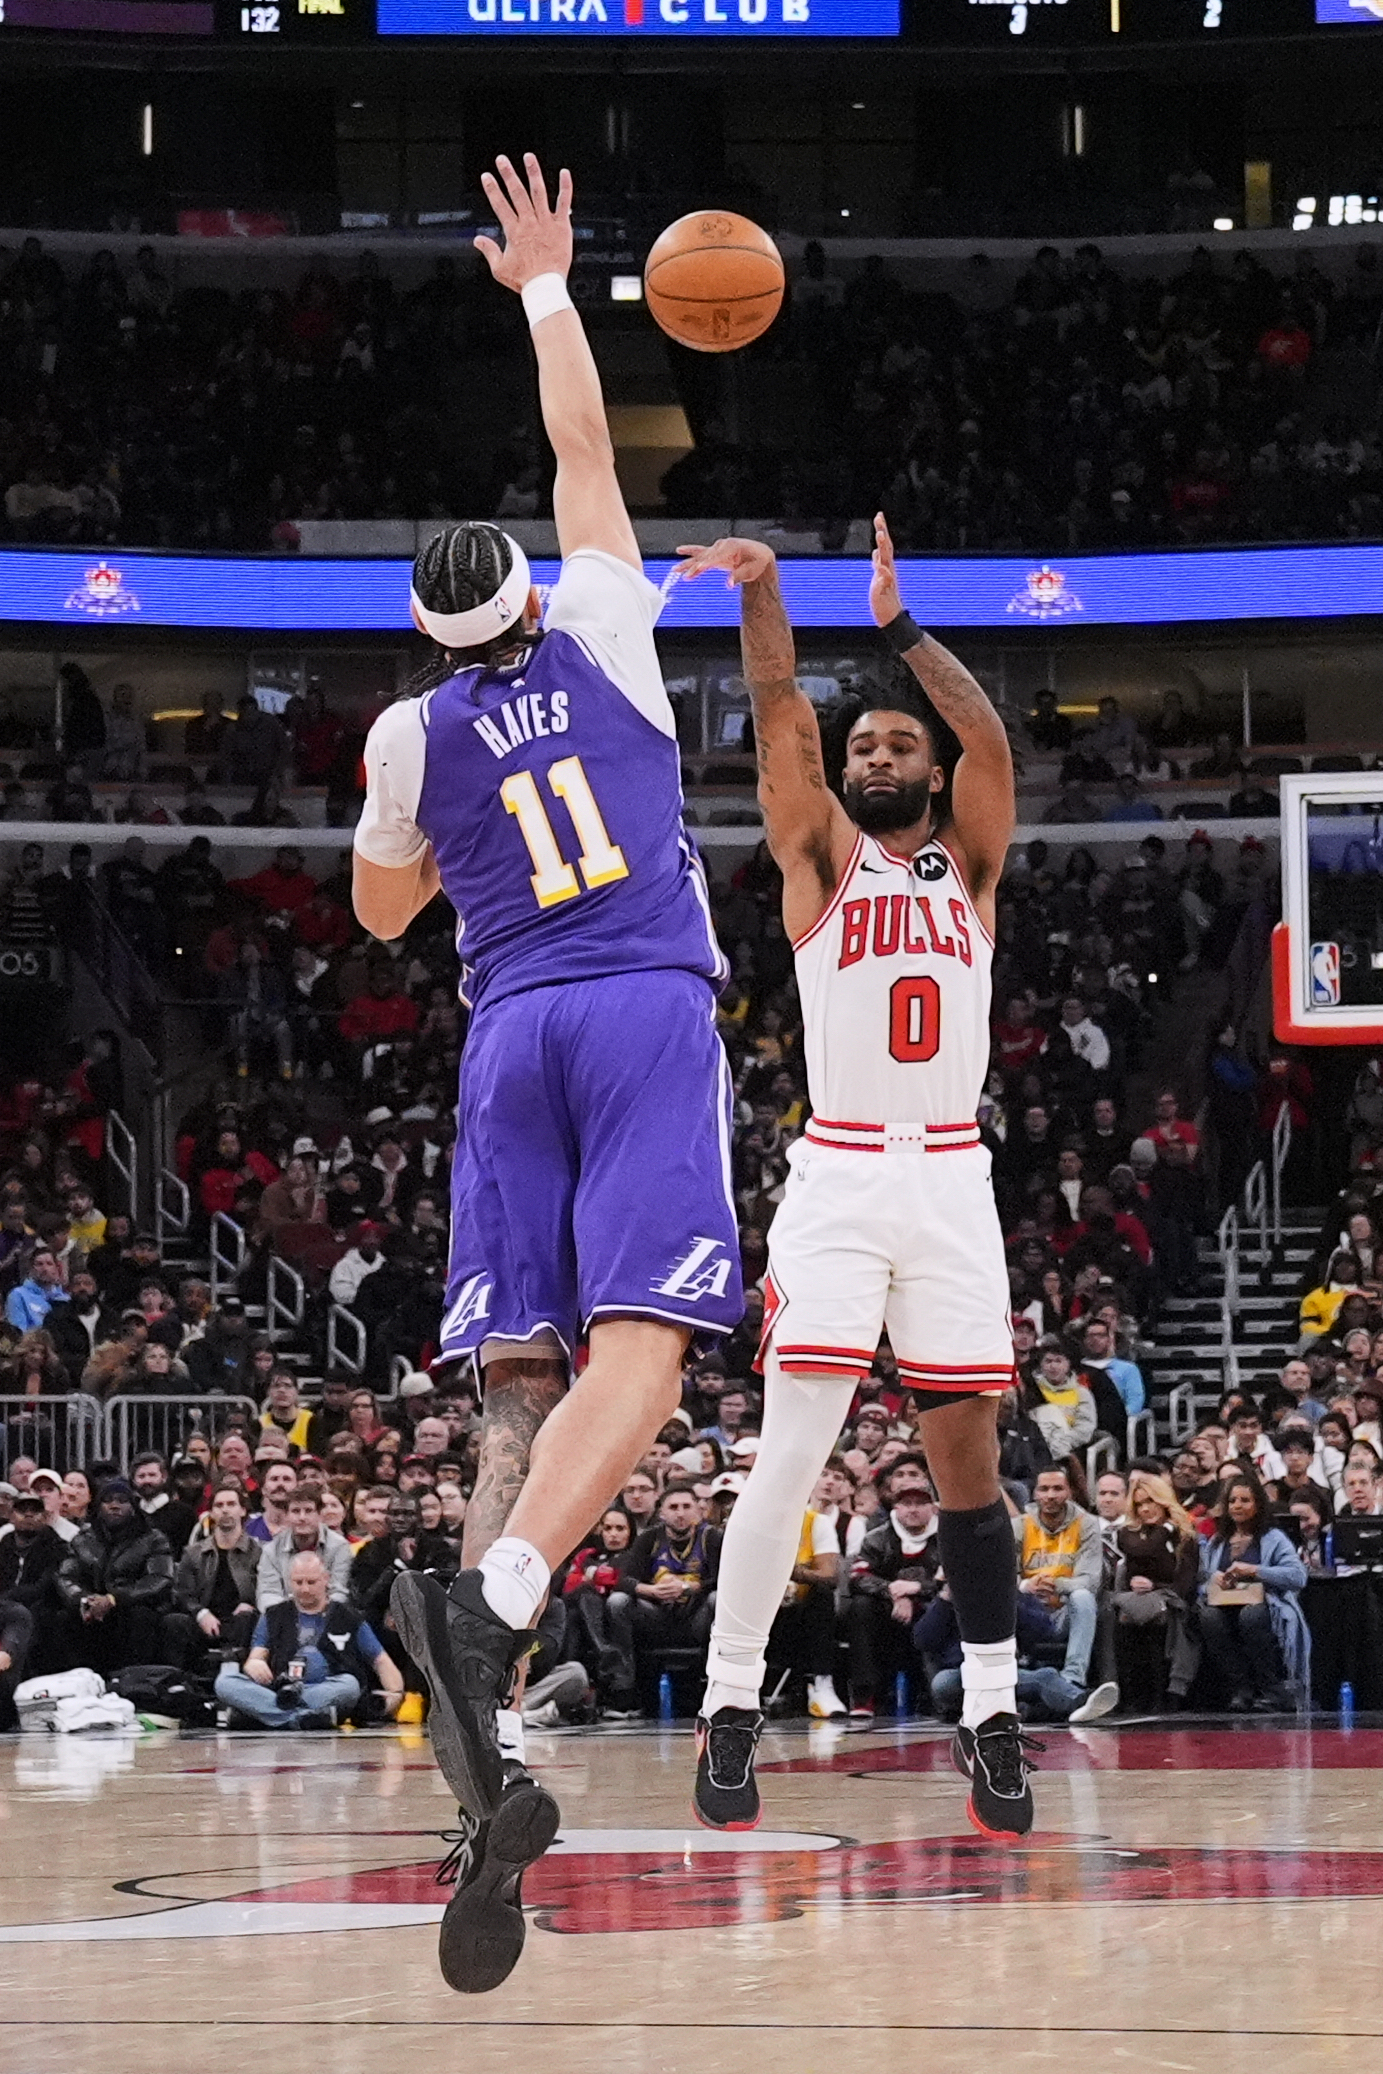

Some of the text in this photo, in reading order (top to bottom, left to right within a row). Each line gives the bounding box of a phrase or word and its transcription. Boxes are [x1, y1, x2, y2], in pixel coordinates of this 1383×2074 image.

[241, 6, 280, 32] 132
[660, 0, 810, 22] CLUB
[473, 690, 569, 759] HAYES
[500, 755, 630, 909] 11
[838, 894, 972, 970] BULLS
[889, 975, 940, 1063] 0
[649, 1237, 732, 1301] LA
[440, 1271, 492, 1344] LA
